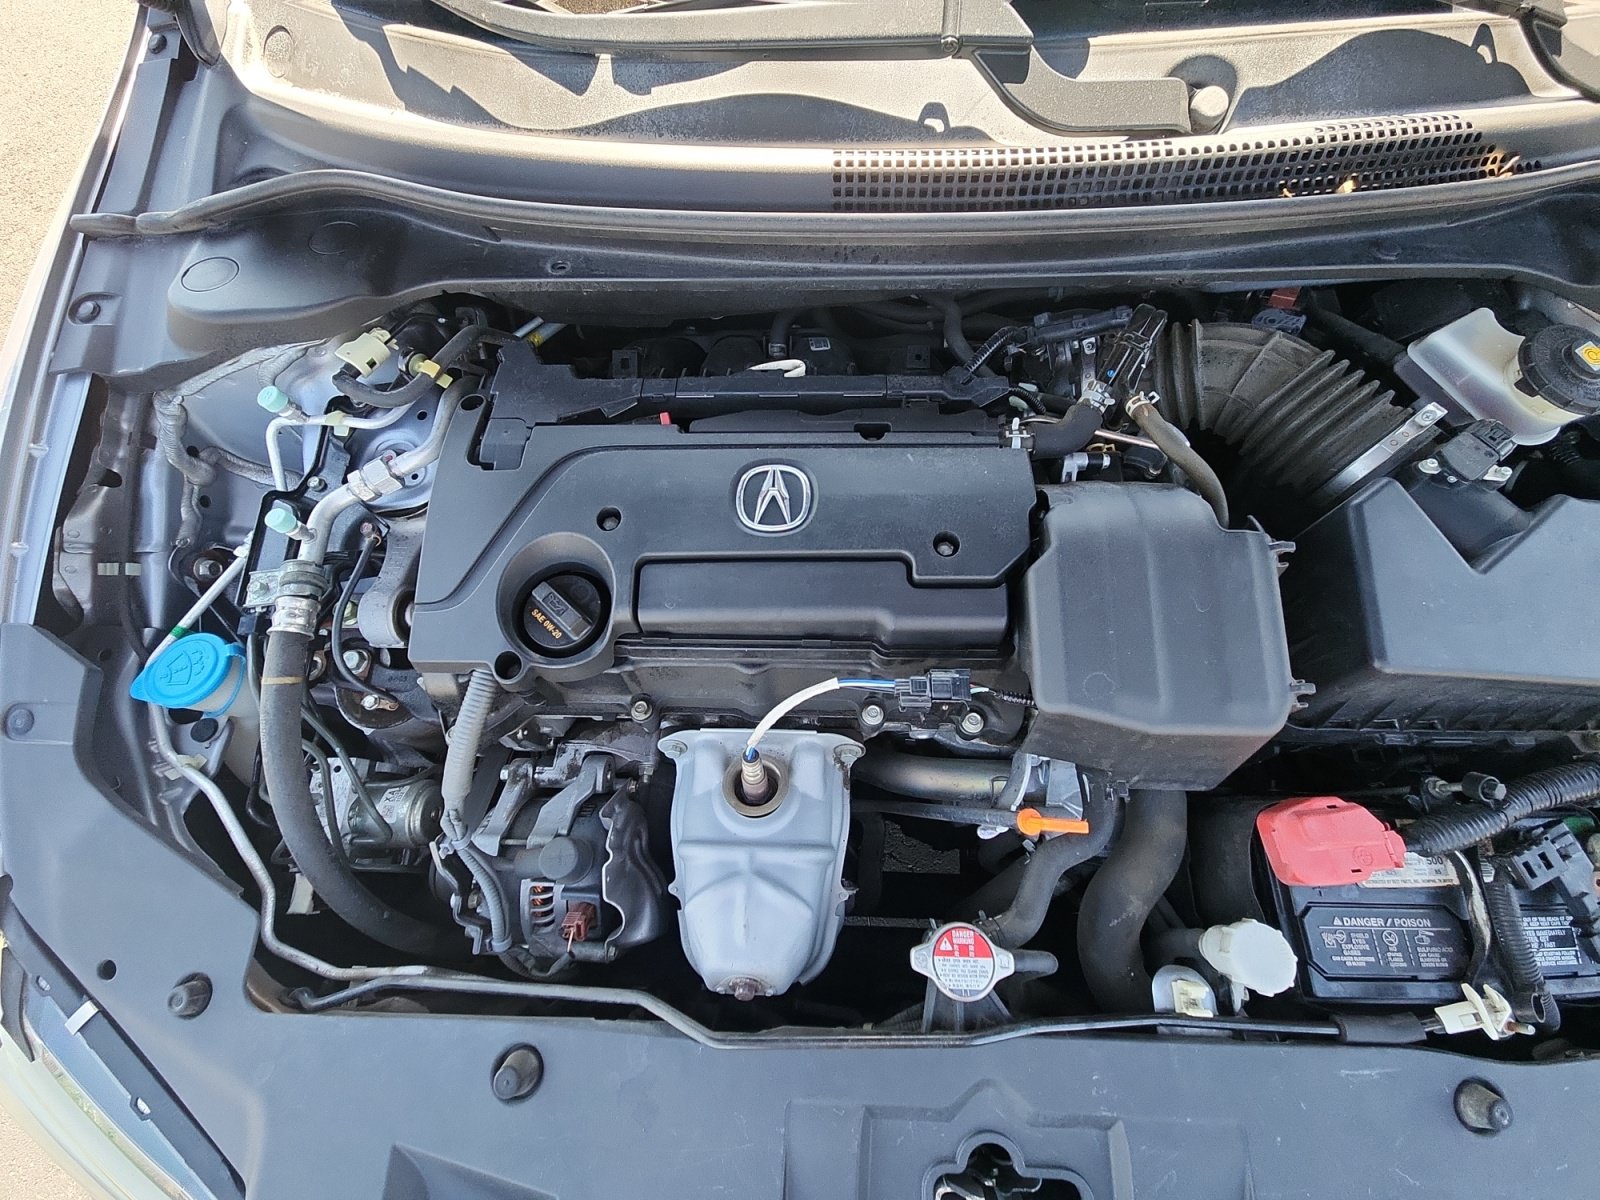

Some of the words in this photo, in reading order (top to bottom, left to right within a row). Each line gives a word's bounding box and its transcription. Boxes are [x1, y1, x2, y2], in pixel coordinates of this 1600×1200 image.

[531, 608, 546, 623] SAE
[543, 620, 562, 639] 0W-20
[1342, 917, 1385, 926] DANGER
[1386, 917, 1392, 926] /
[1394, 918, 1431, 927] POISON
